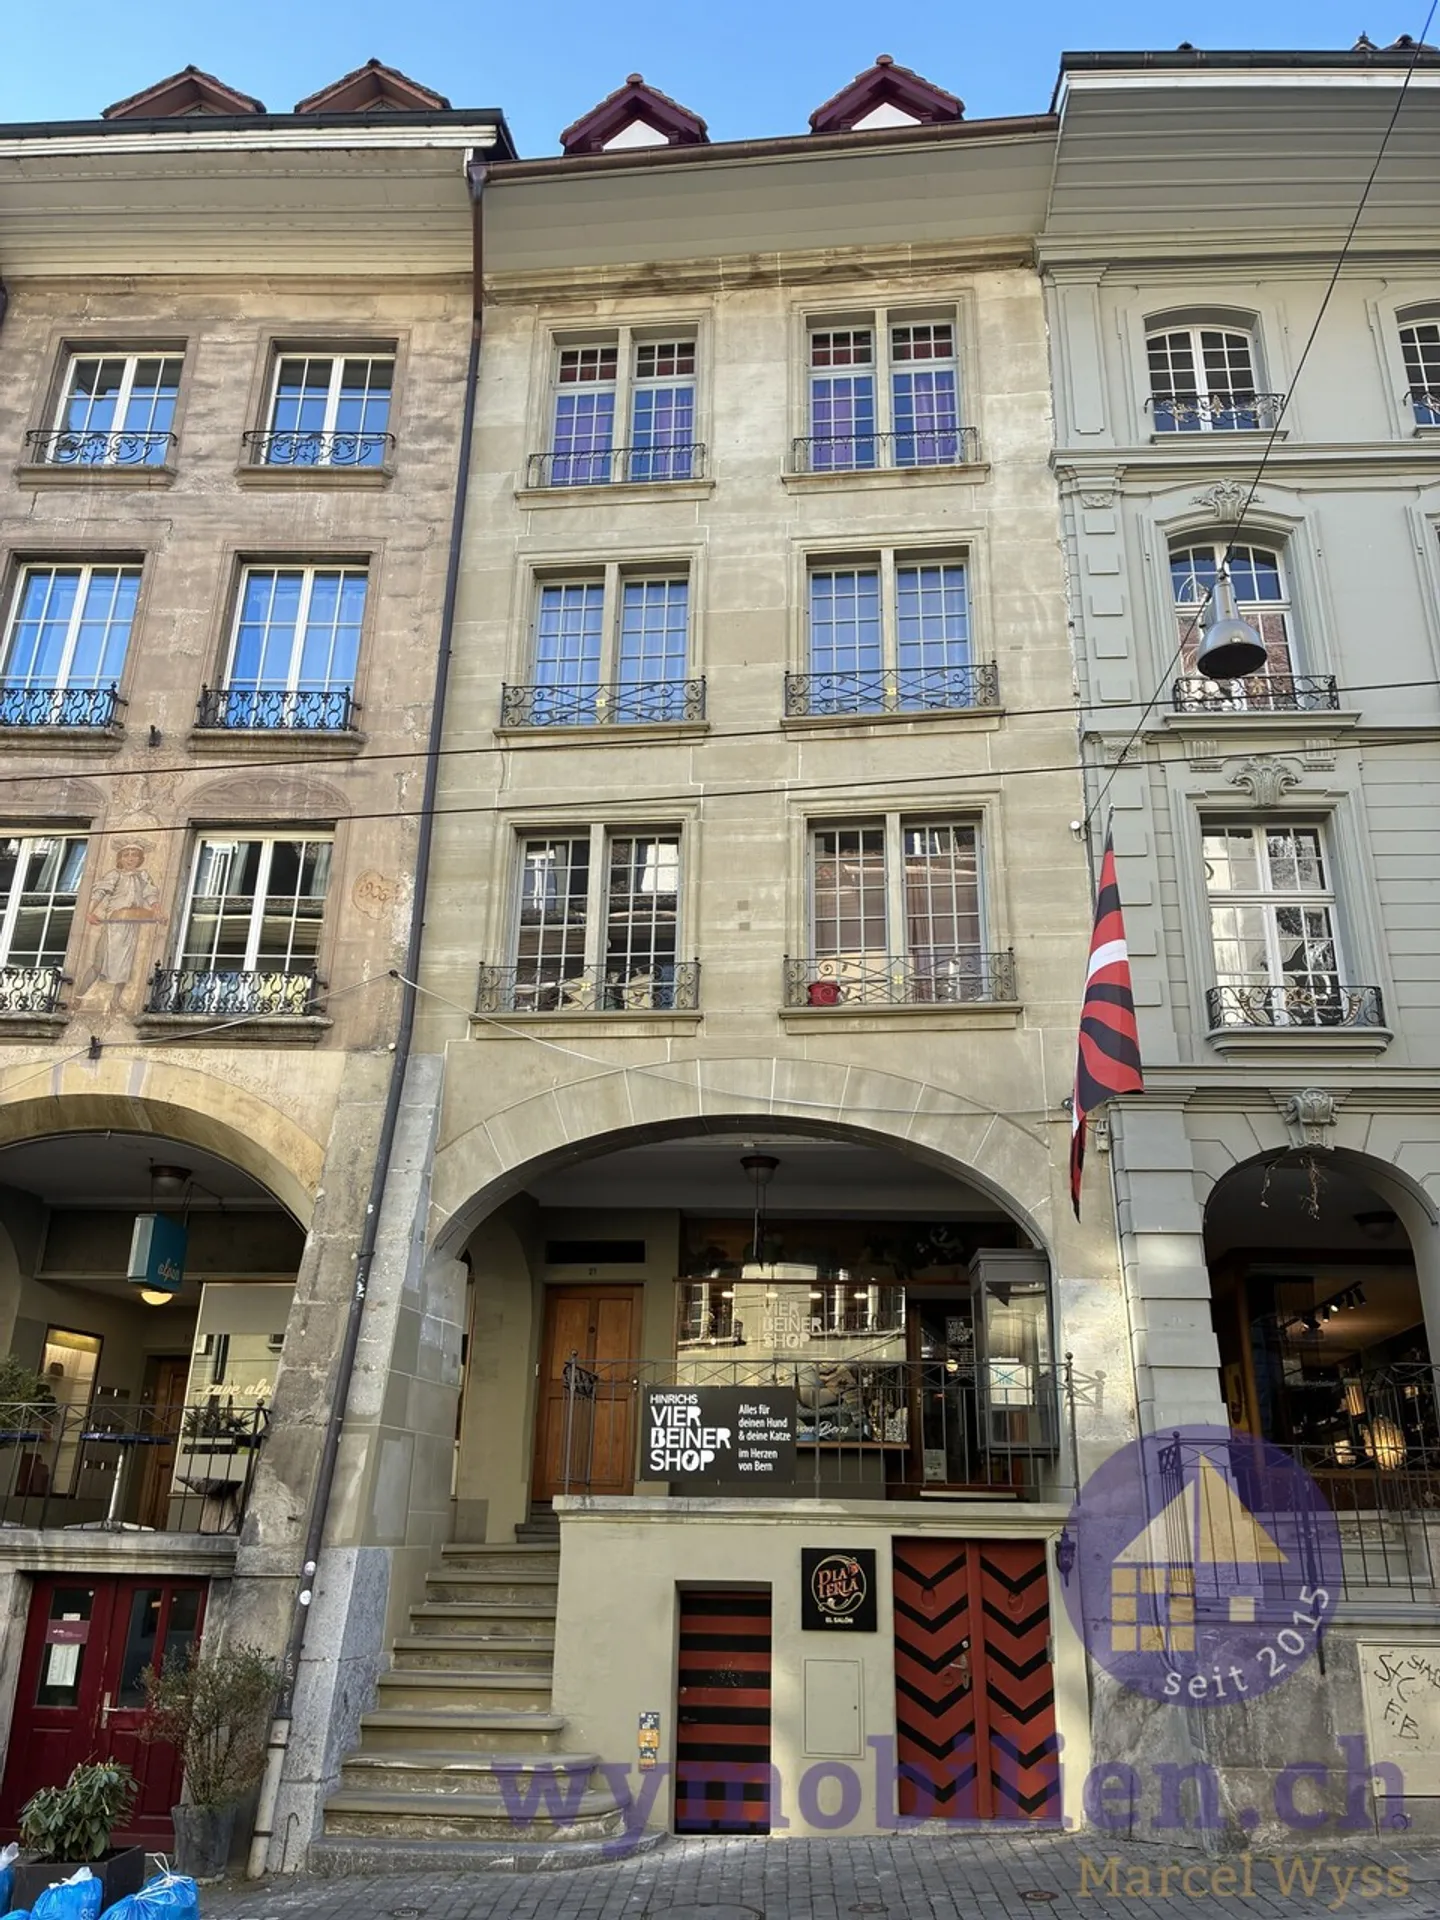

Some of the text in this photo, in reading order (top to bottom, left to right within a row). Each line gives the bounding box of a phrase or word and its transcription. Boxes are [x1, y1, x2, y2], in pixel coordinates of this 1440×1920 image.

[763, 1301, 799, 1317] VIER
[762, 1317, 822, 1332] BEINER
[762, 1333, 811, 1348] SHOP
[650, 1393, 699, 1404] HINRICHS
[650, 1405, 701, 1427] VIER
[738, 1404, 771, 1415] Alles für
[738, 1417, 788, 1428] deinen Hund
[650, 1427, 731, 1449] BEINER
[738, 1430, 792, 1441] & deine Katze
[738, 1448, 778, 1459] im Herzen
[650, 1450, 715, 1471] SHOP
[738, 1460, 773, 1471] von Bern
